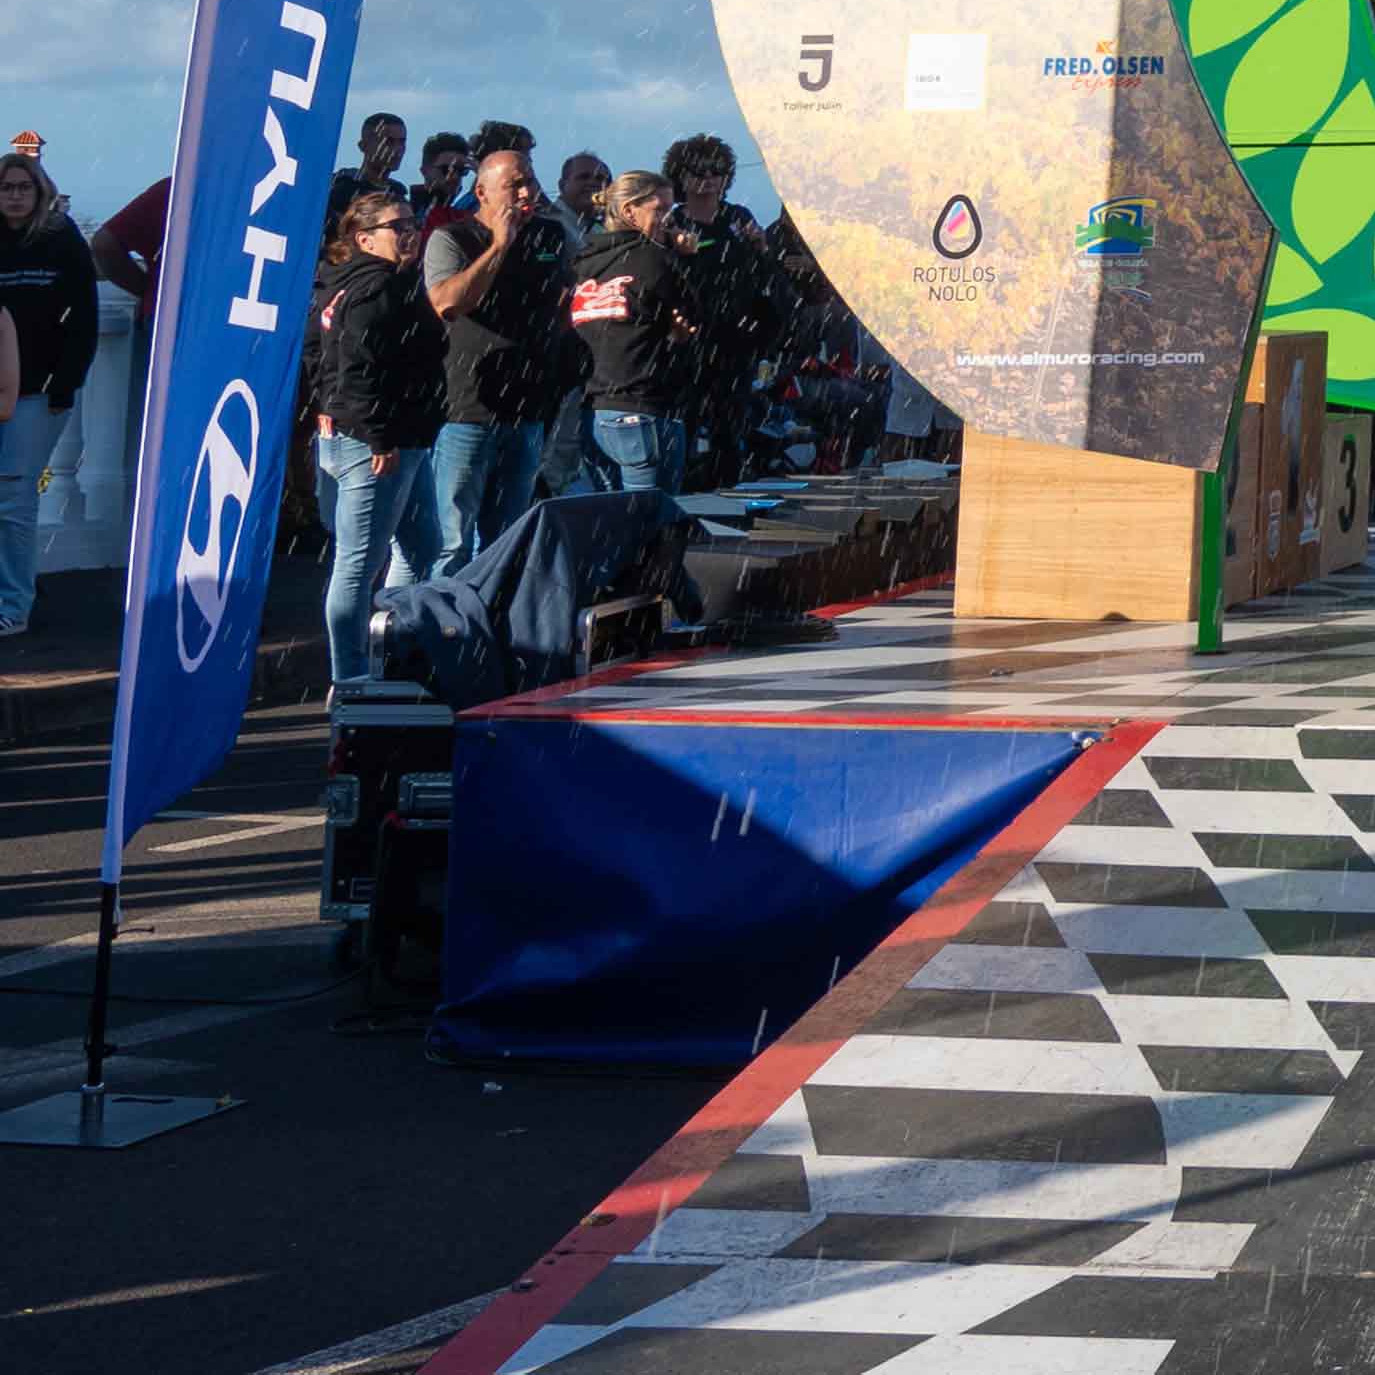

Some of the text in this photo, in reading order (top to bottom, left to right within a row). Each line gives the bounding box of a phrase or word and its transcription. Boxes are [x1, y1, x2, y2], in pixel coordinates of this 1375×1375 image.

[1043, 56, 1164, 75] FRED. OLSEN
[928, 285, 978, 302] NOLO
[957, 350, 1205, 368] www.elmuroracing.com
[1338, 433, 1357, 533] 3
